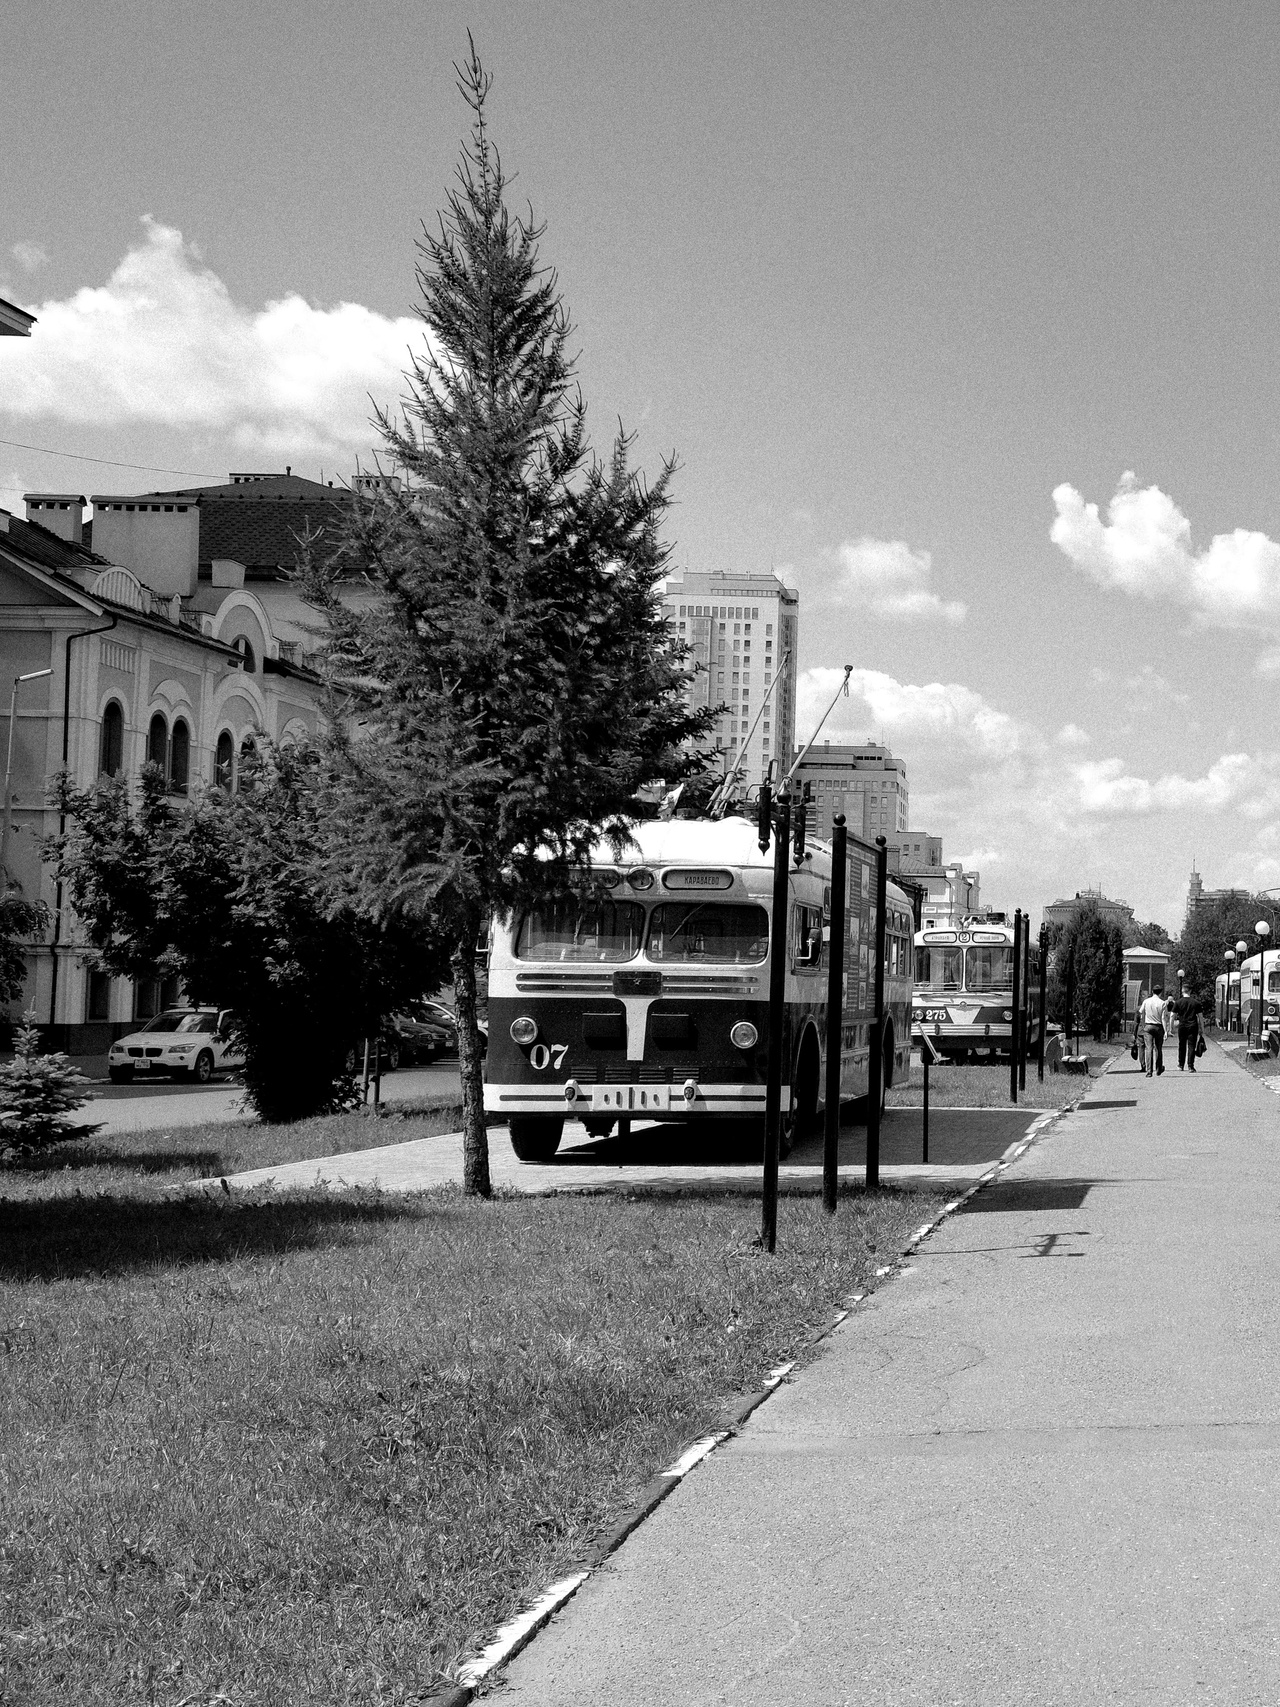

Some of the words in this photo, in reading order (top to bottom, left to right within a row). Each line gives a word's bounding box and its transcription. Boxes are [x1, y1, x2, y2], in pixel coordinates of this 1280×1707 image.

[684, 876, 720, 885] КАРАВАЕВО
[925, 1009, 947, 1021] 275
[530, 1044, 569, 1069] 07
